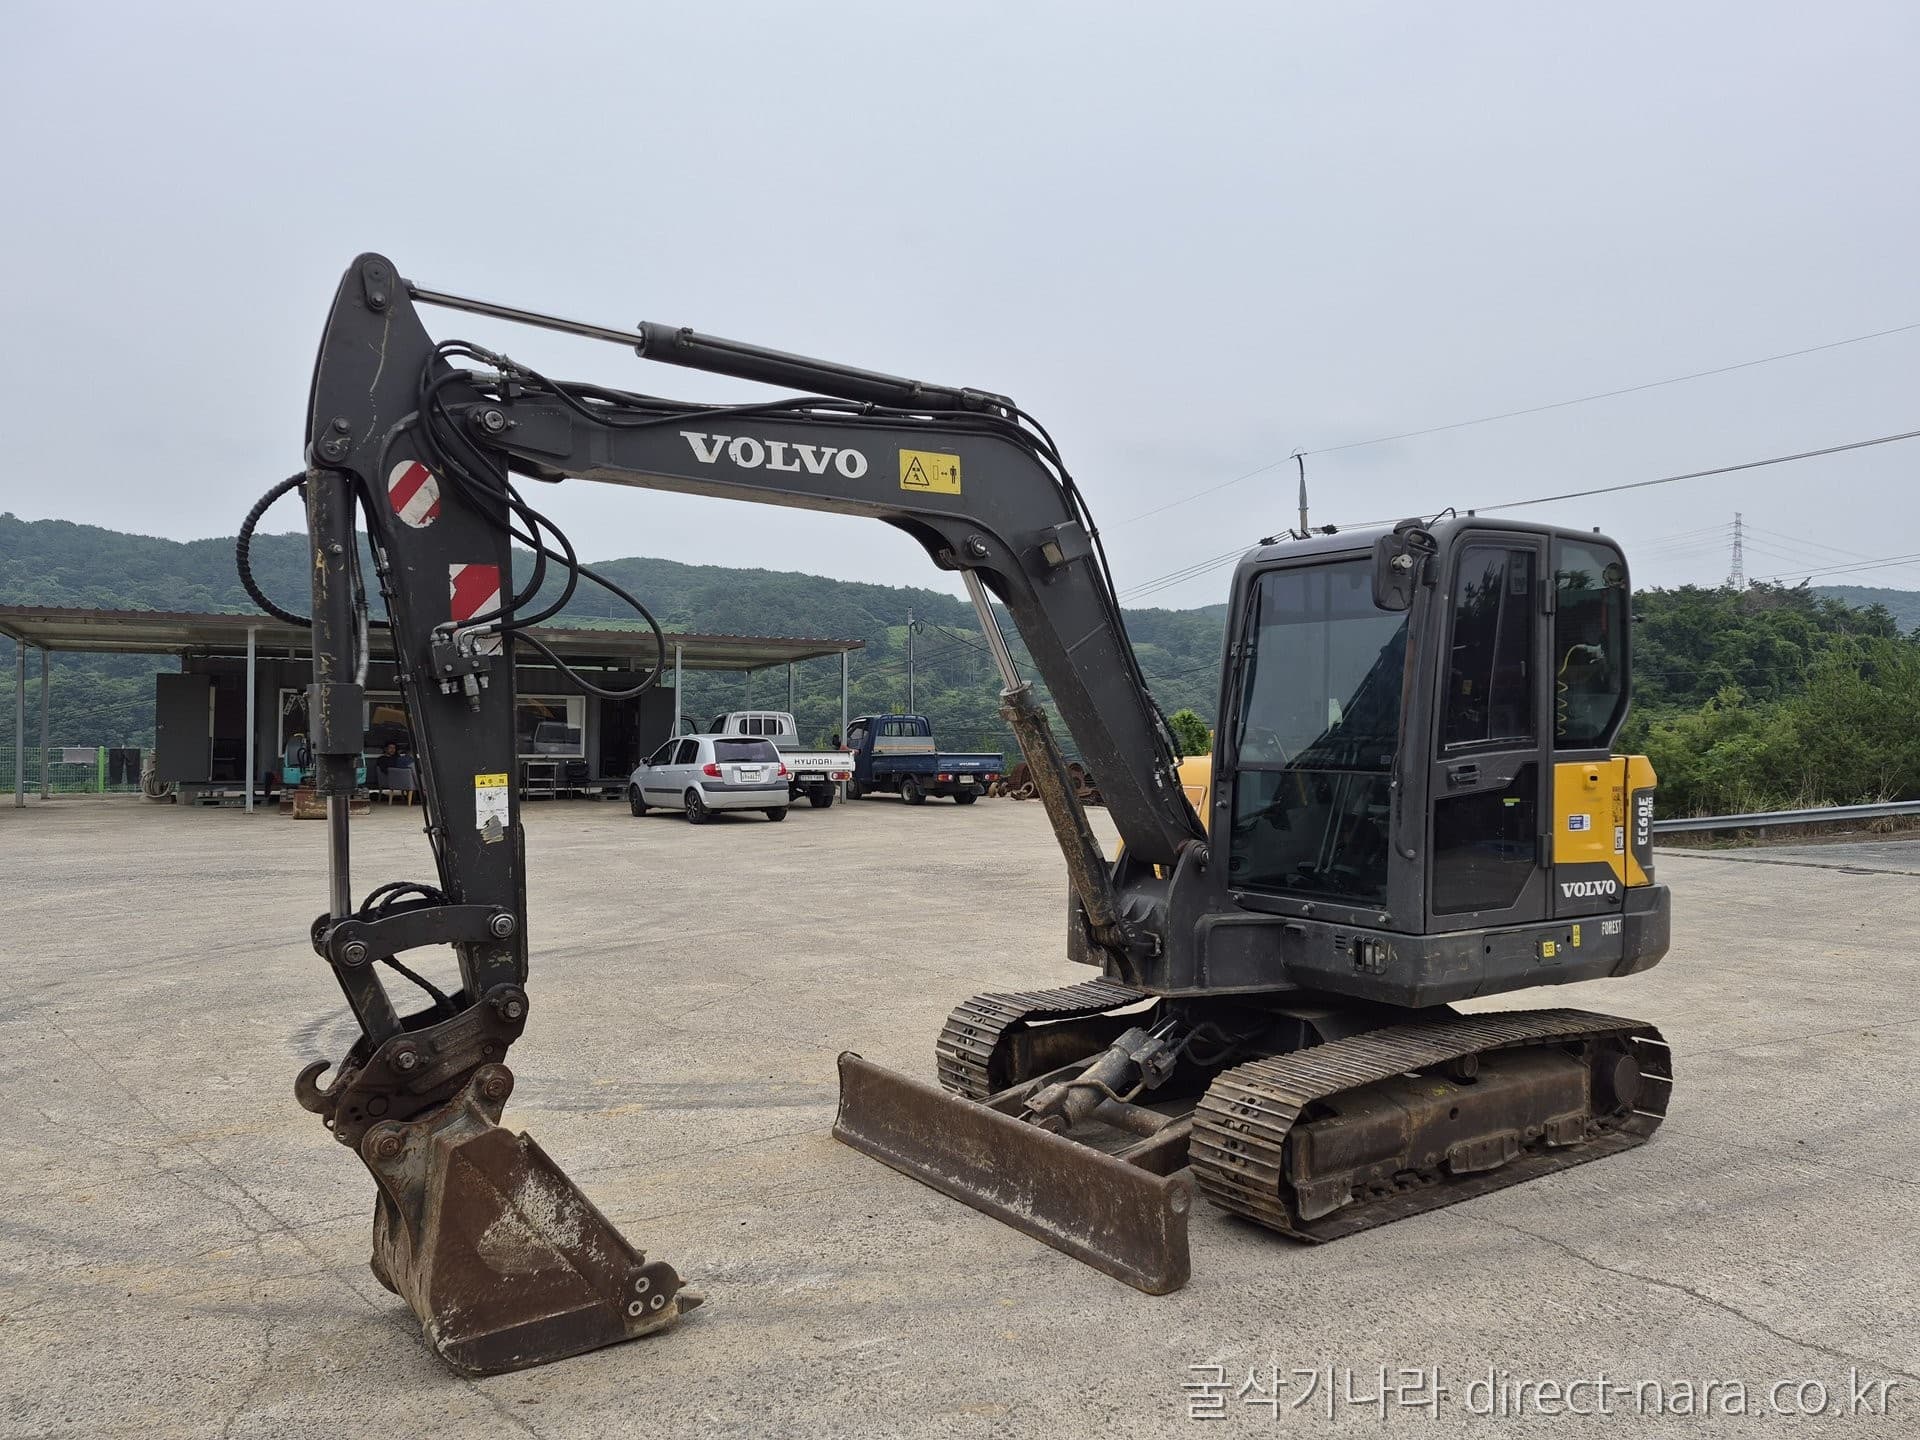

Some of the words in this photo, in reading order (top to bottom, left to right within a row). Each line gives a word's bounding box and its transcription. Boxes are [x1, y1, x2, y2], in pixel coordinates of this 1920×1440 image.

[680, 430, 868, 479] VOLVO
[1638, 797, 1649, 845] EC60E
[1561, 880, 1616, 898] VOLVO
[1601, 920, 1621, 935] FOREST
